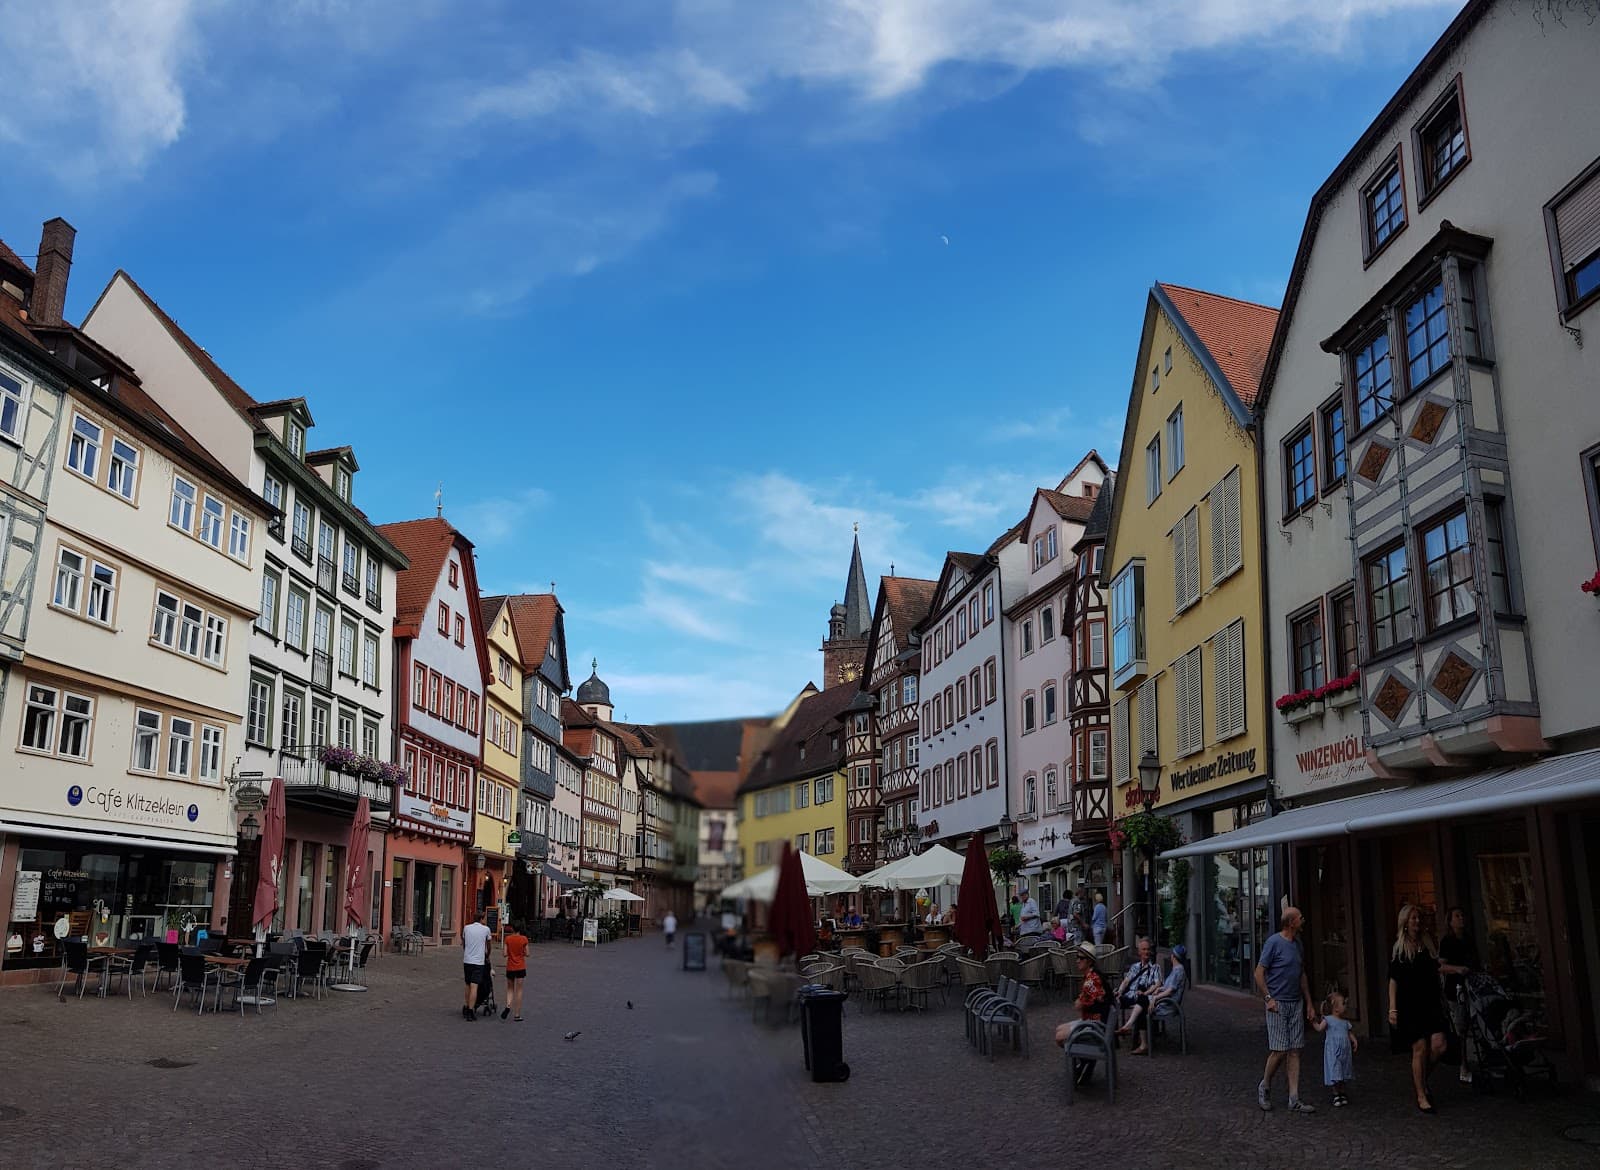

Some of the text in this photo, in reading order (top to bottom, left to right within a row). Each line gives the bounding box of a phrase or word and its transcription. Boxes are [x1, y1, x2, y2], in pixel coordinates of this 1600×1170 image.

[1170, 747, 1256, 792] Wertheimer Zeitung
[1296, 734, 1367, 773] WINZENHÖL
[87, 787, 185, 816] Café Klitzeklein
